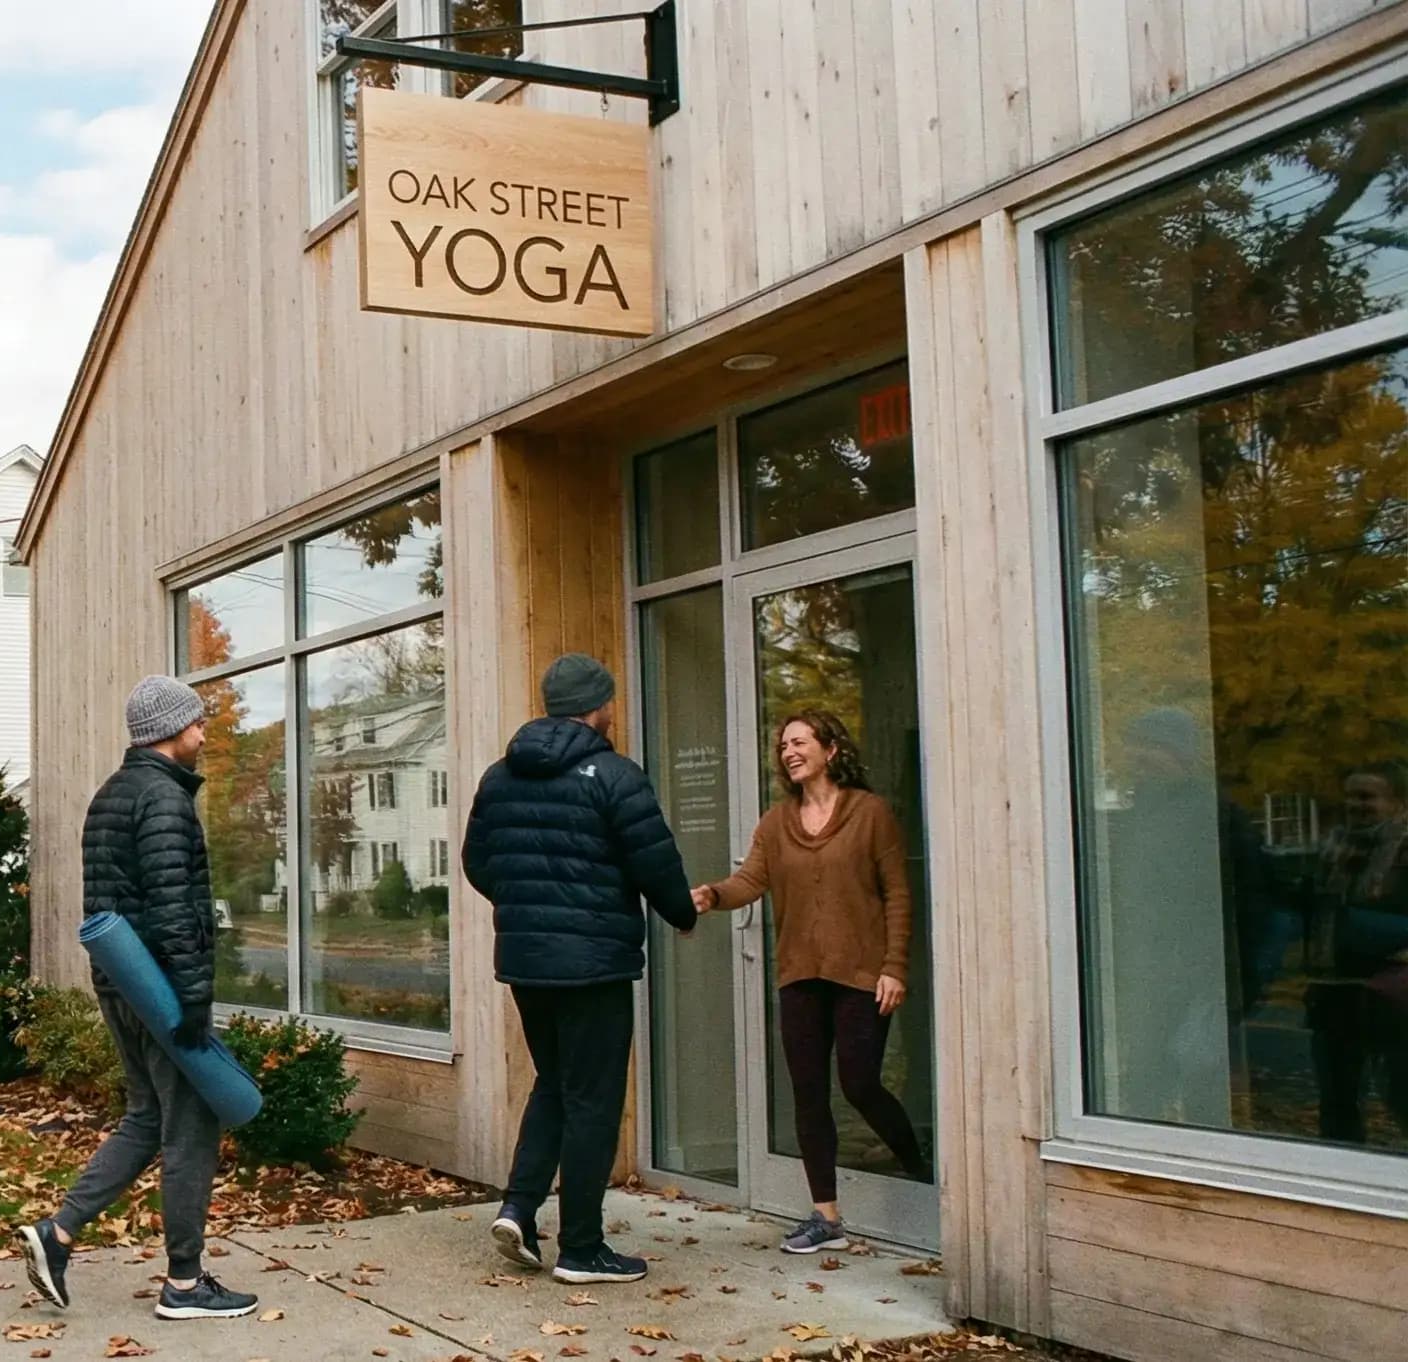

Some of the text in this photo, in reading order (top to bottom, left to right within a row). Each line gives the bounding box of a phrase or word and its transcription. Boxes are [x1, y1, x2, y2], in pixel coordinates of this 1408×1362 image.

[389, 169, 630, 230] OAK STREET
[390, 220, 630, 310] YOGA
